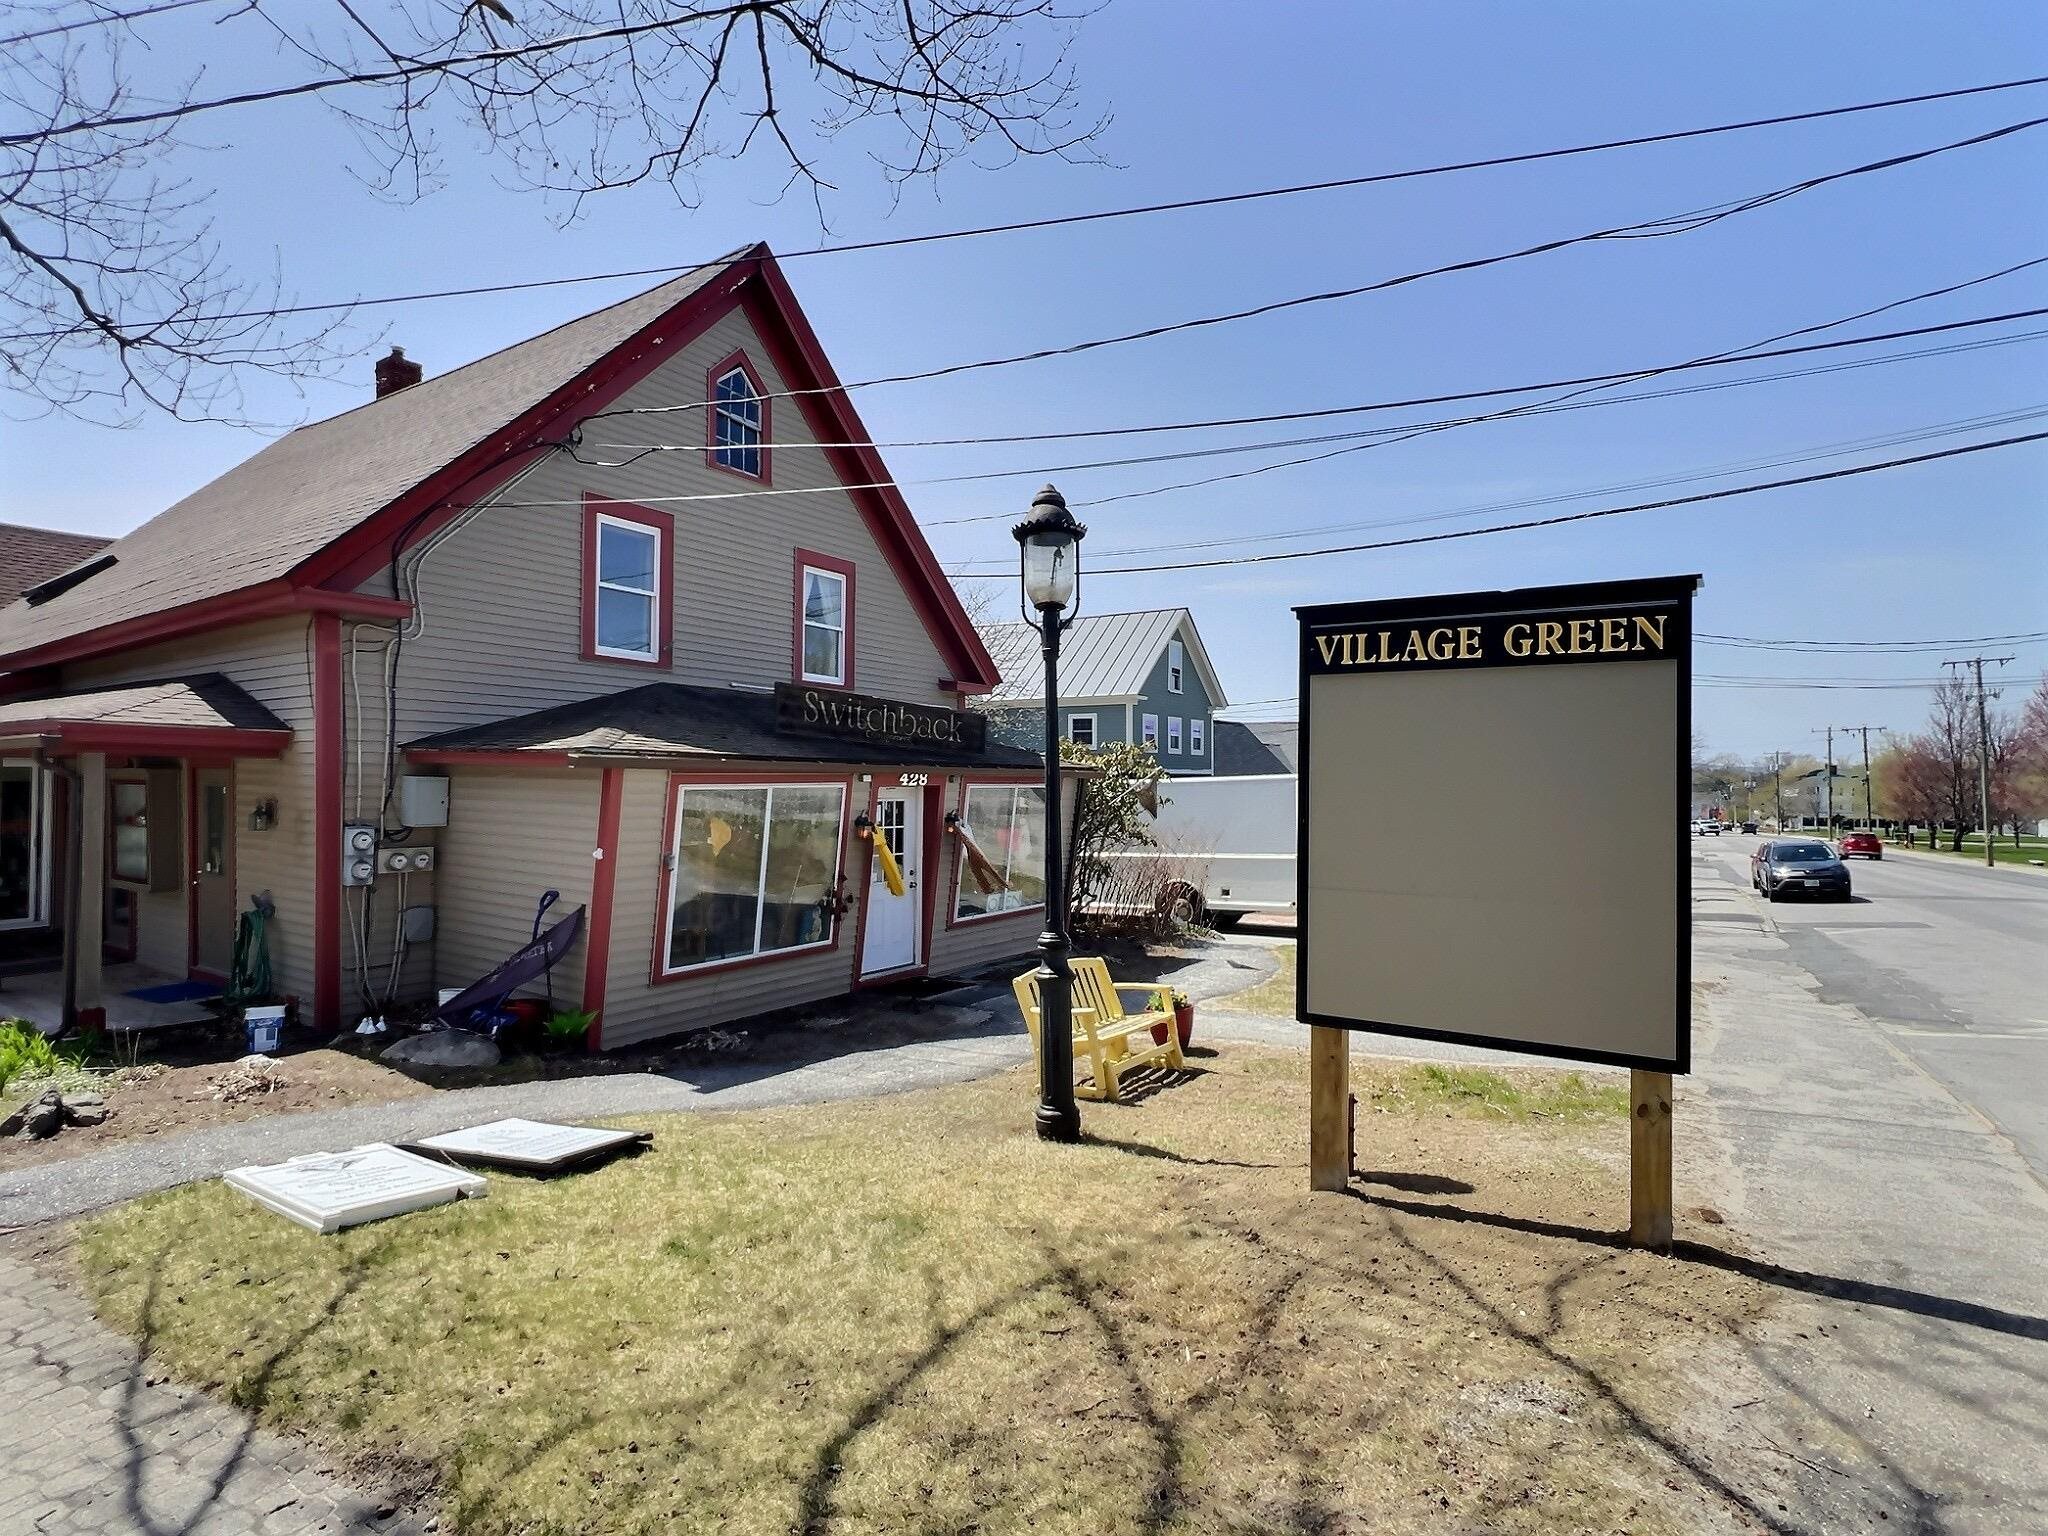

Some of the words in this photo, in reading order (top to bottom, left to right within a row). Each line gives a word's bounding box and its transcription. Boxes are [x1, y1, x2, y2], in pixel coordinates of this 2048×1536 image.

[1315, 627, 1483, 666] VILLAGE
[1503, 615, 1669, 656] GREEN
[803, 691, 963, 743] Switchback
[899, 772, 929, 787] 428
[988, 894, 1024, 911] OEN
